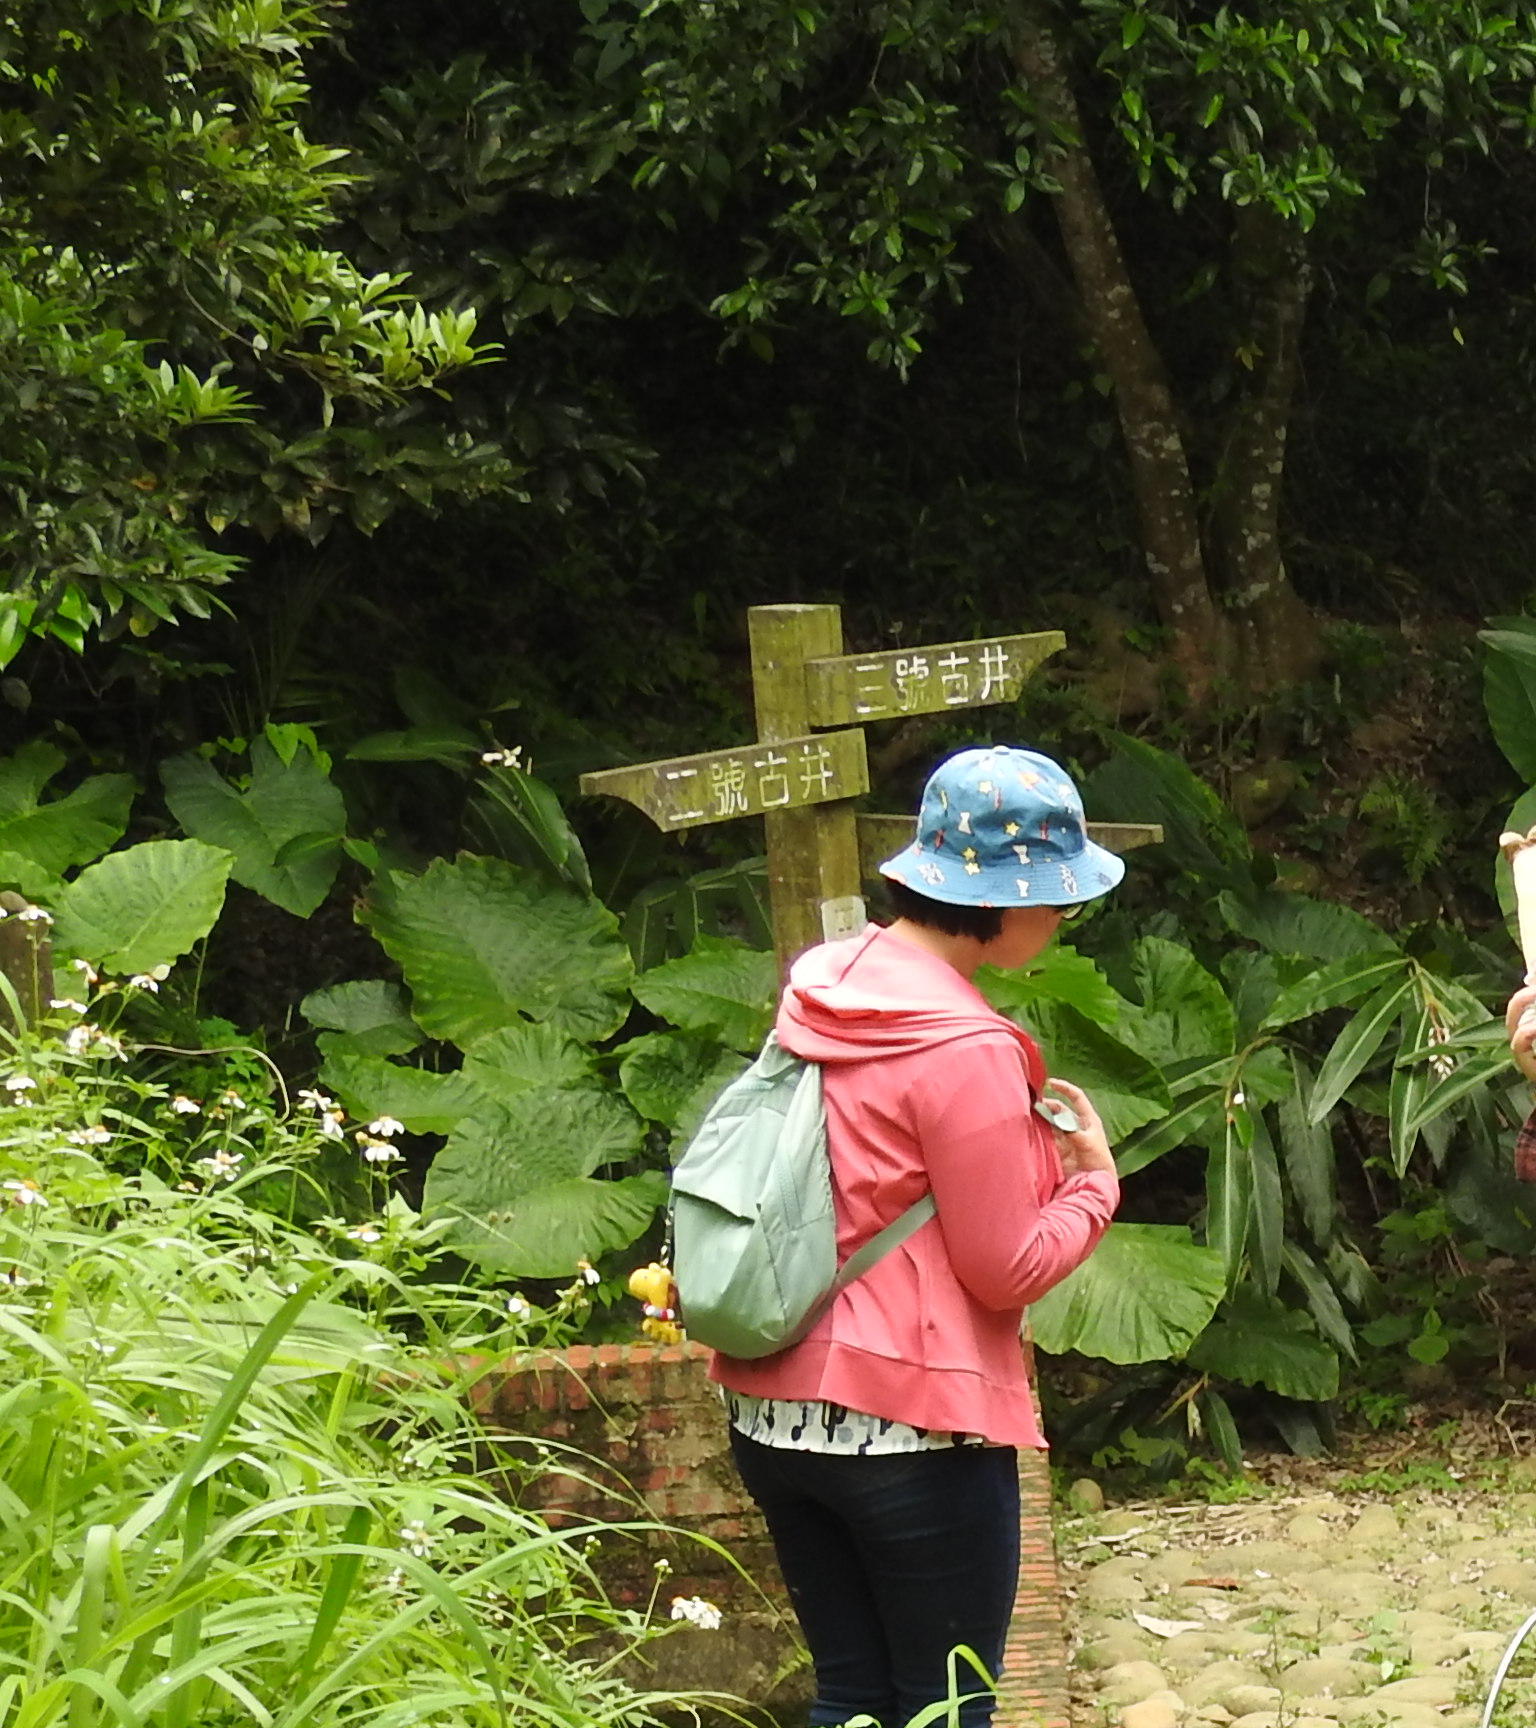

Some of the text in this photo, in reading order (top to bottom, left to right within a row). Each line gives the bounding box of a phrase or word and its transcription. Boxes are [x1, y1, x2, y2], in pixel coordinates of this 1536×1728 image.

[856, 645, 1010, 714] 三號古井
[666, 744, 834, 821] 二號古井
